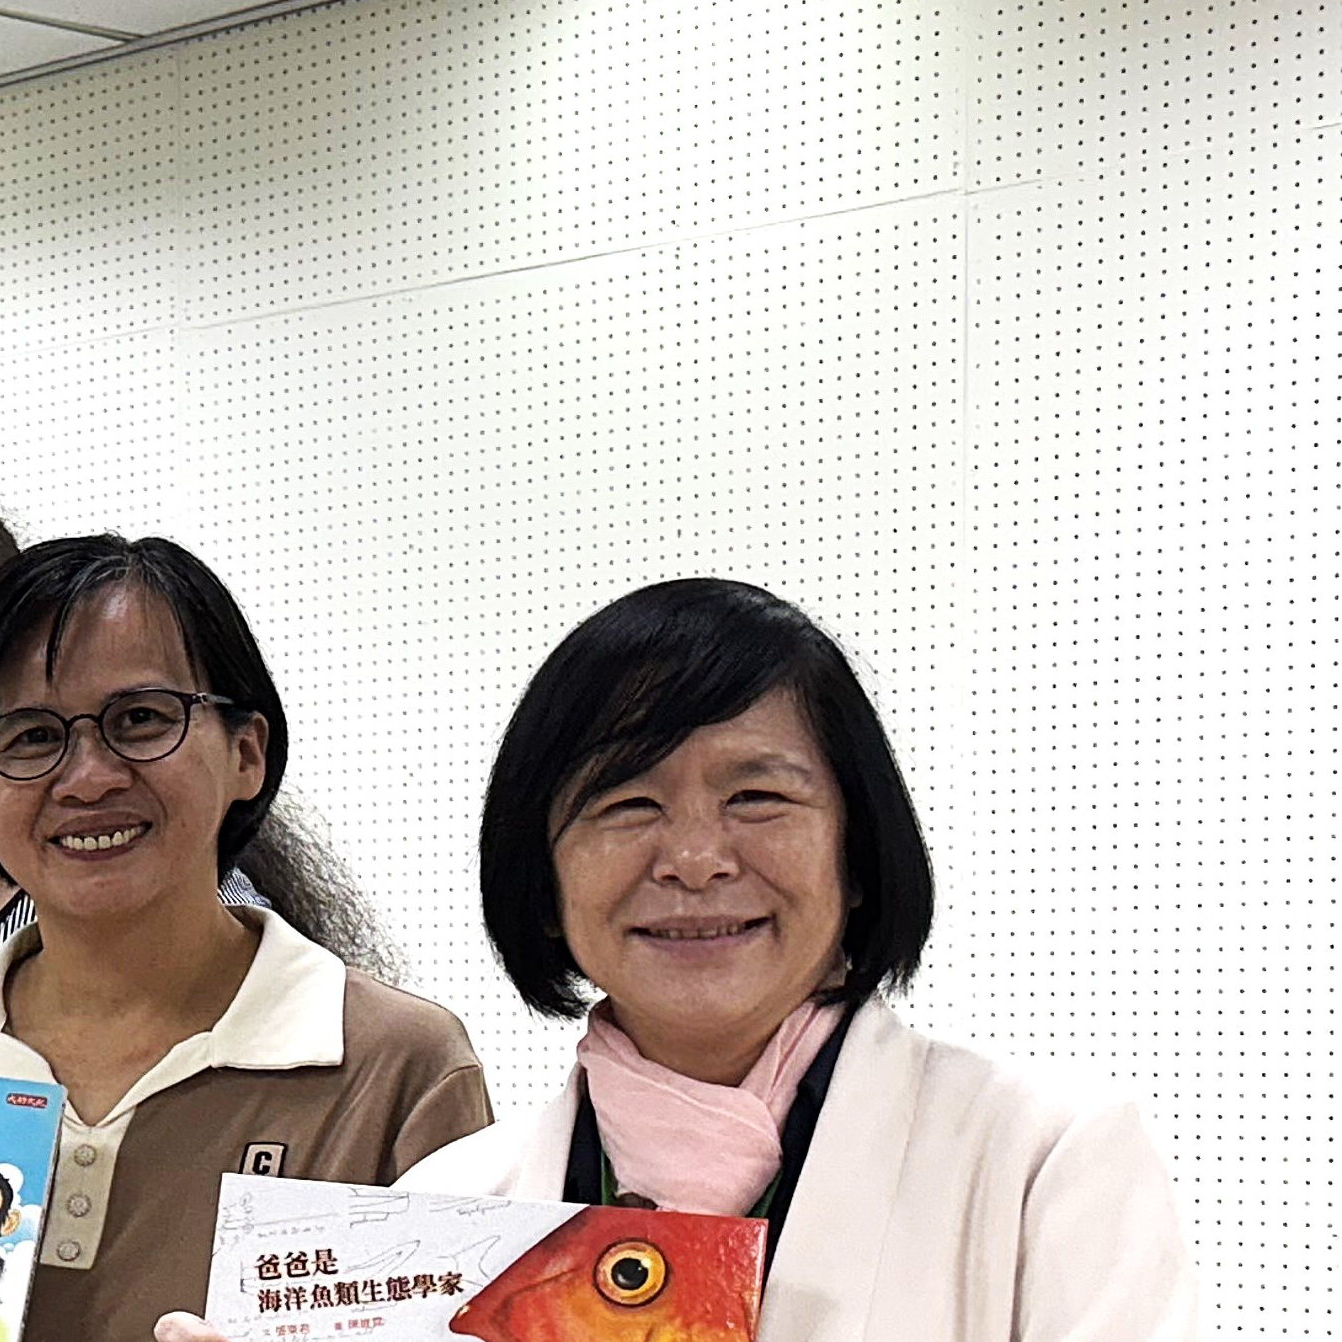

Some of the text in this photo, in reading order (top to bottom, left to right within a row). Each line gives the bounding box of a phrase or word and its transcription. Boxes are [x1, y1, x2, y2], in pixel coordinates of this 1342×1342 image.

[254, 1248, 339, 1281] 爸爸是
[257, 1271, 465, 1314] 海洋魚類生態學家
